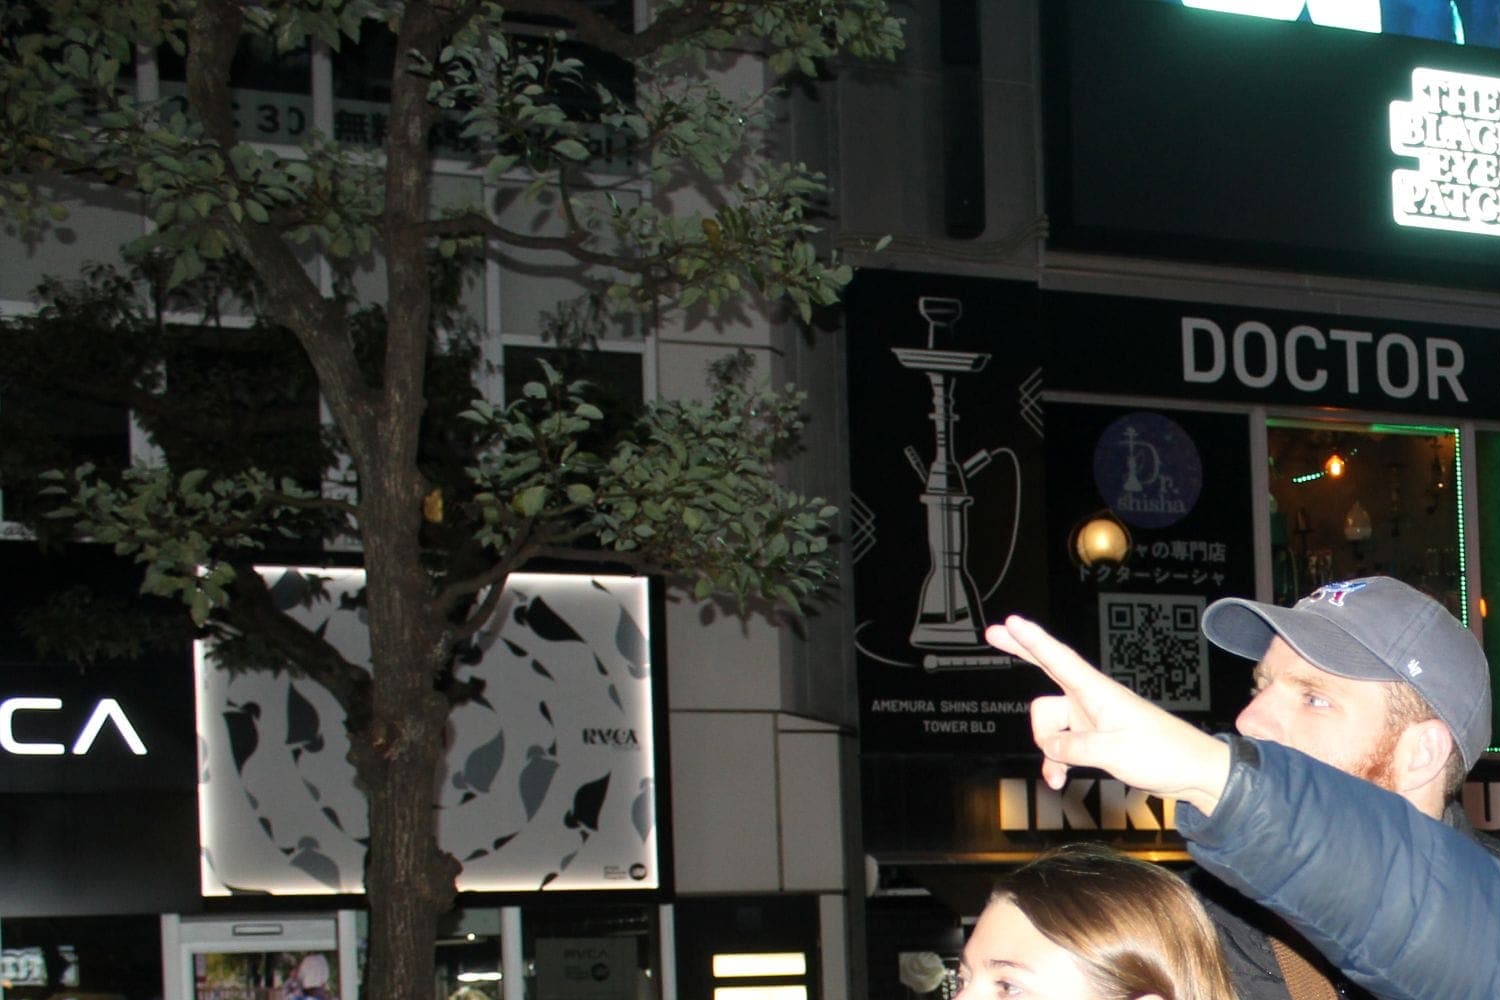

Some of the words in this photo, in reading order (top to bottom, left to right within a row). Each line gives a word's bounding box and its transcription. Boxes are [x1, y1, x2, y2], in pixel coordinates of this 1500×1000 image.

[1180, 317, 1470, 403] DOCTOR
[1135, 539, 1228, 562] ャの専門店
[871, 699, 936, 713] AMEMURA
[923, 720, 969, 733] TOWER
[971, 721, 996, 734] BLD
[582, 728, 639, 746] RVCA
